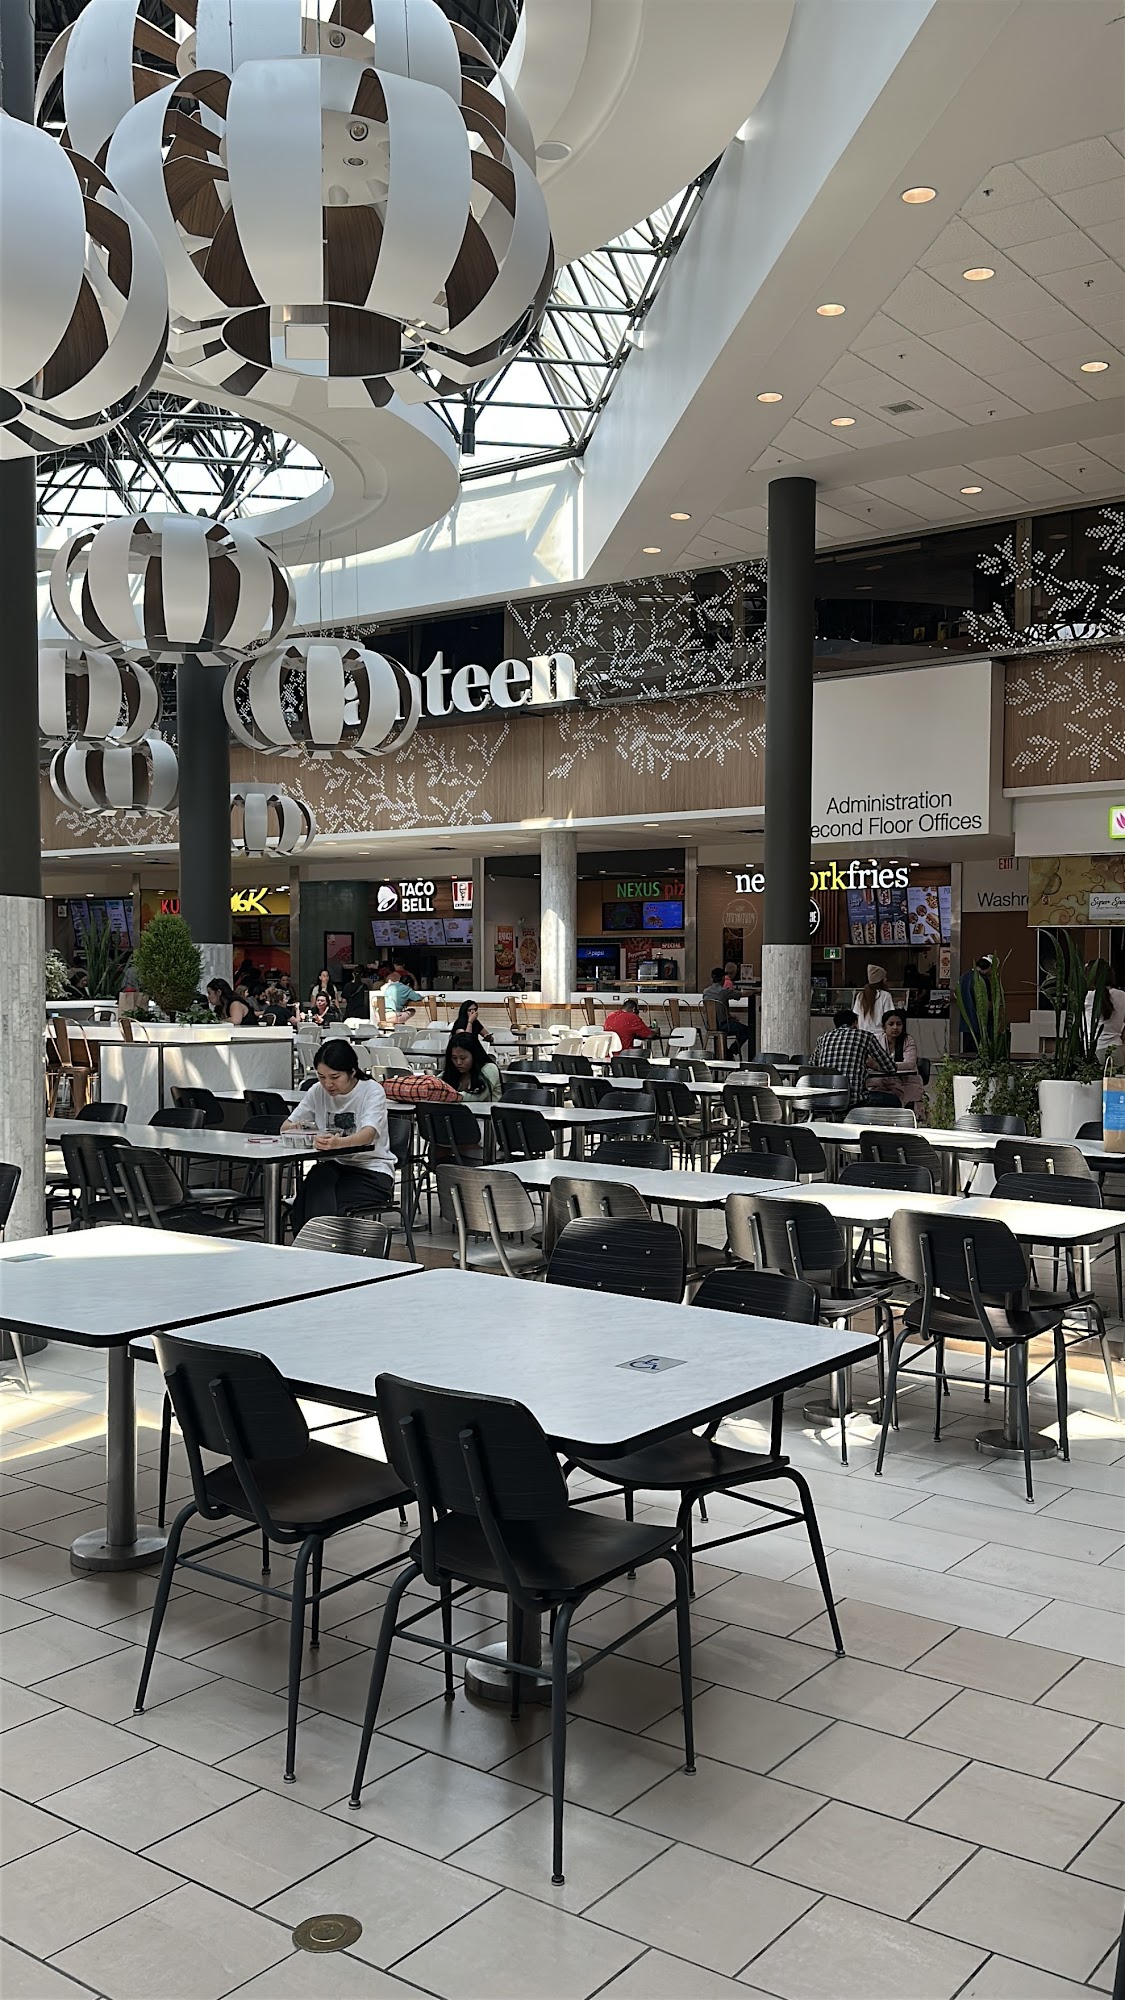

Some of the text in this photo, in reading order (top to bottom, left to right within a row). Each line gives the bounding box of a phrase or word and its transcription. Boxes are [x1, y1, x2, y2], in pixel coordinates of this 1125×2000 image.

[826, 791, 952, 814] Administration
[811, 812, 982, 838] econd Floor Offices
[998, 857, 1014, 870] EXIT
[399, 881, 435, 897] TACO
[616, 880, 685, 900] NEXUS piz
[161, 899, 180, 914] KU
[401, 897, 434, 912] BELL
[977, 891, 1028, 907] Washr
